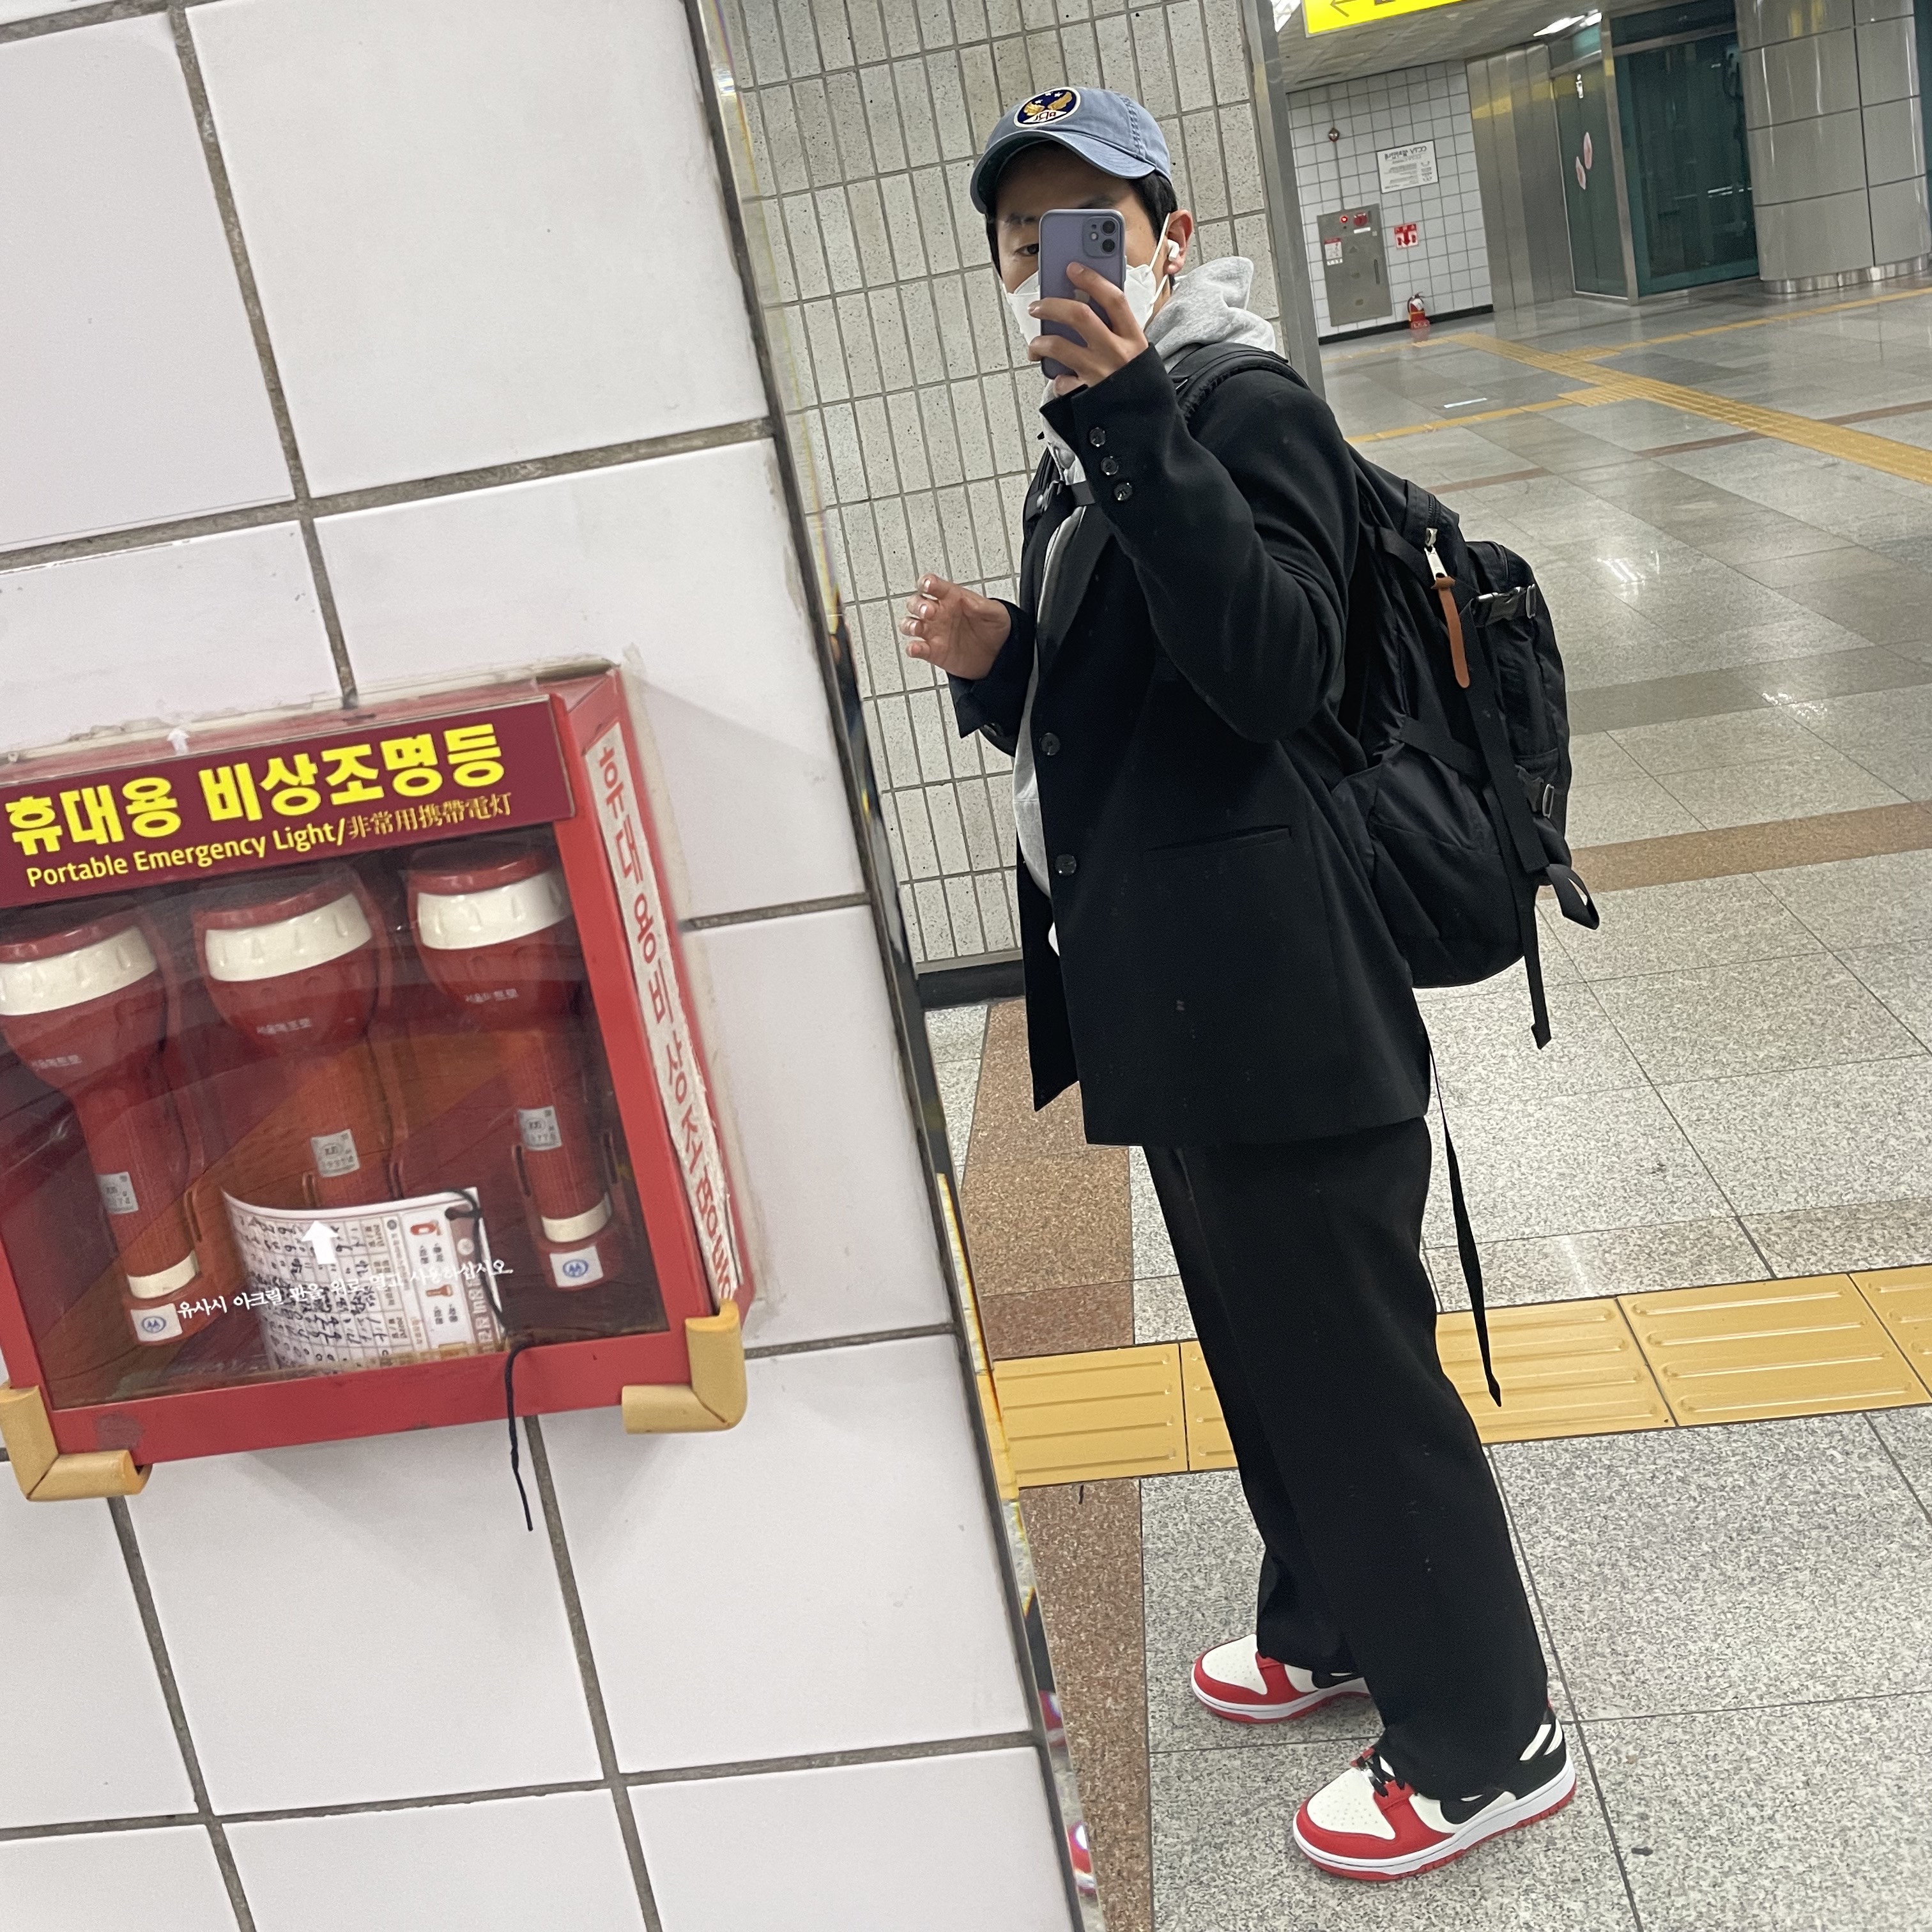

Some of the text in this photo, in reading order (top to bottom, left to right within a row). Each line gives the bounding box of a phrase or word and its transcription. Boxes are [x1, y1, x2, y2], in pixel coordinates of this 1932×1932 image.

[6, 723, 505, 856] 휴대용 비상조명등
[27, 848, 127, 888] Portable
[134, 836, 266, 873] Emergency
[178, 1296, 228, 1320] 유사시
[233, 1287, 284, 1310] 아크릴
[289, 1282, 324, 1302] 판을
[330, 1278, 365, 1296] 위로
